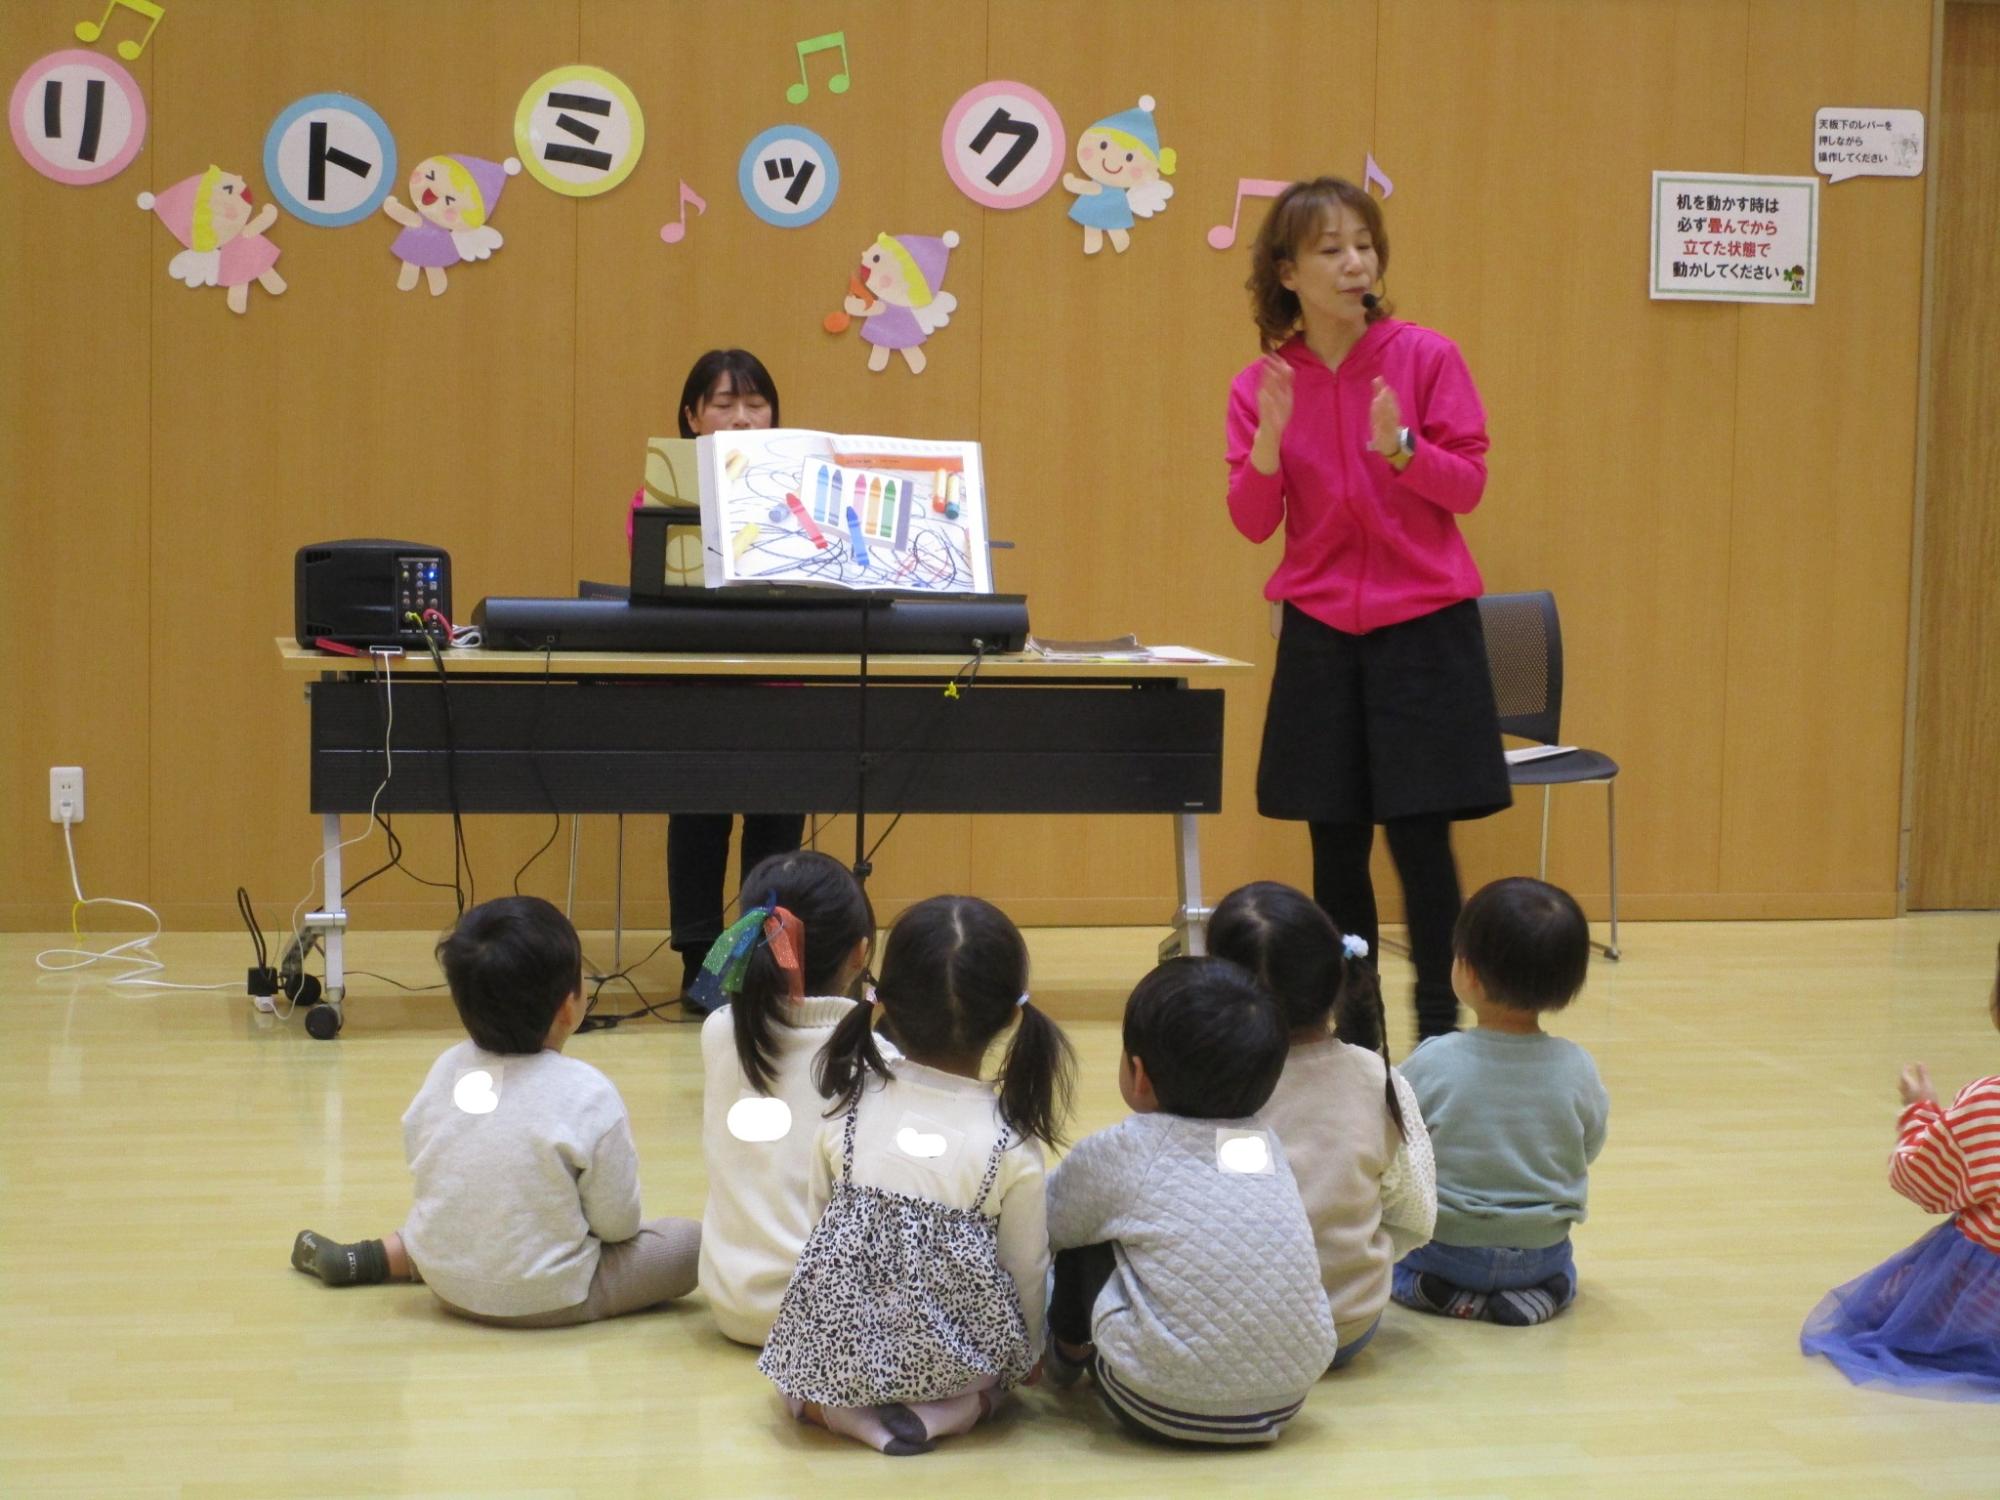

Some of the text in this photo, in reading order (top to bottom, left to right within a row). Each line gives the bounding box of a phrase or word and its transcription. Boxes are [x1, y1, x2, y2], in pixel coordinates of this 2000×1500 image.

[1818, 119, 1893, 131] 天板下のレバーを
[1818, 135, 1864, 147] 押しながら
[1818, 151, 1889, 163] 操作してください
[1676, 193, 1780, 213] 机を動かす時は
[1677, 217, 1778, 236] 必ず畳んでから
[1682, 239, 1772, 258] 立てた状態で
[1672, 260, 1780, 281] 動かしてください
